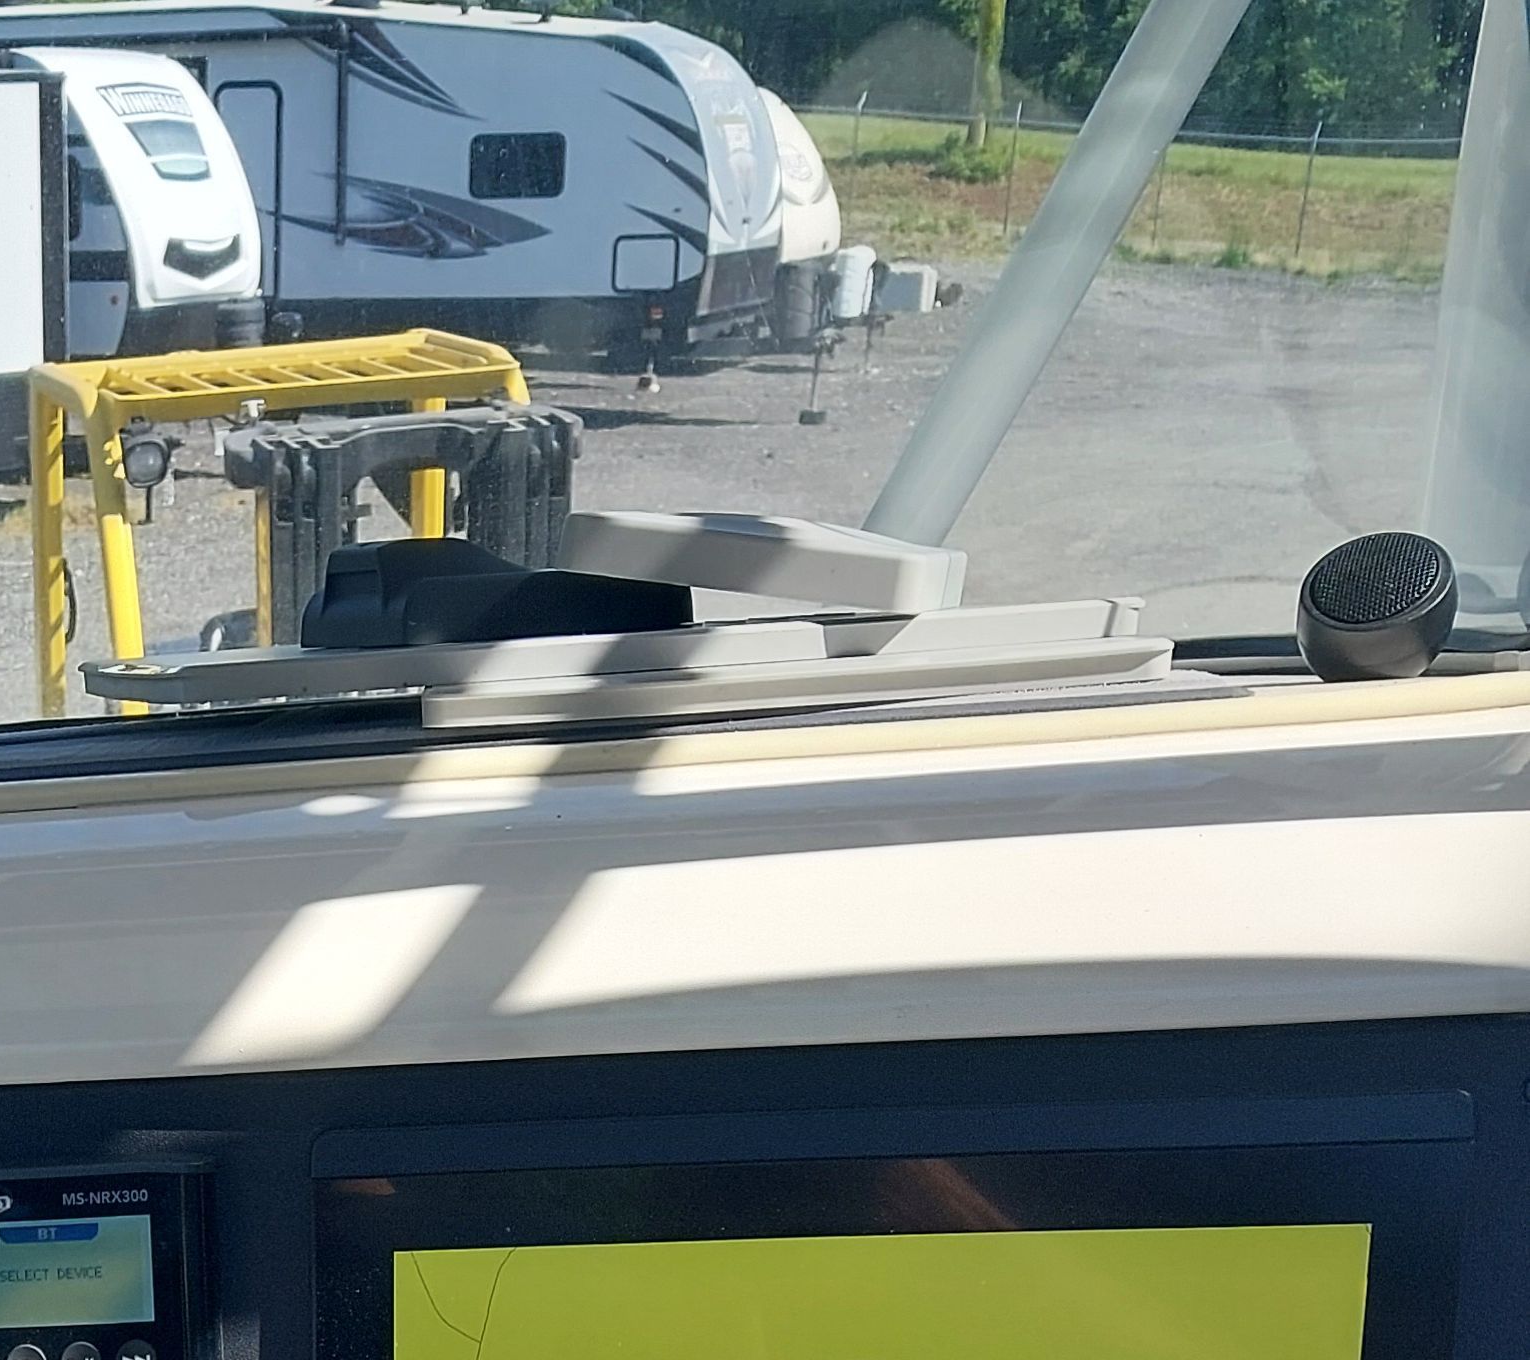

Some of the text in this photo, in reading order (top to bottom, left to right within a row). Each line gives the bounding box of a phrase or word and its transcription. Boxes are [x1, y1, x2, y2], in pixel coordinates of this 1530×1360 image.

[62, 1188, 149, 1207] MS-NRX300
[37, 1227, 57, 1241] BT
[56, 1266, 103, 1281] DEVICE
